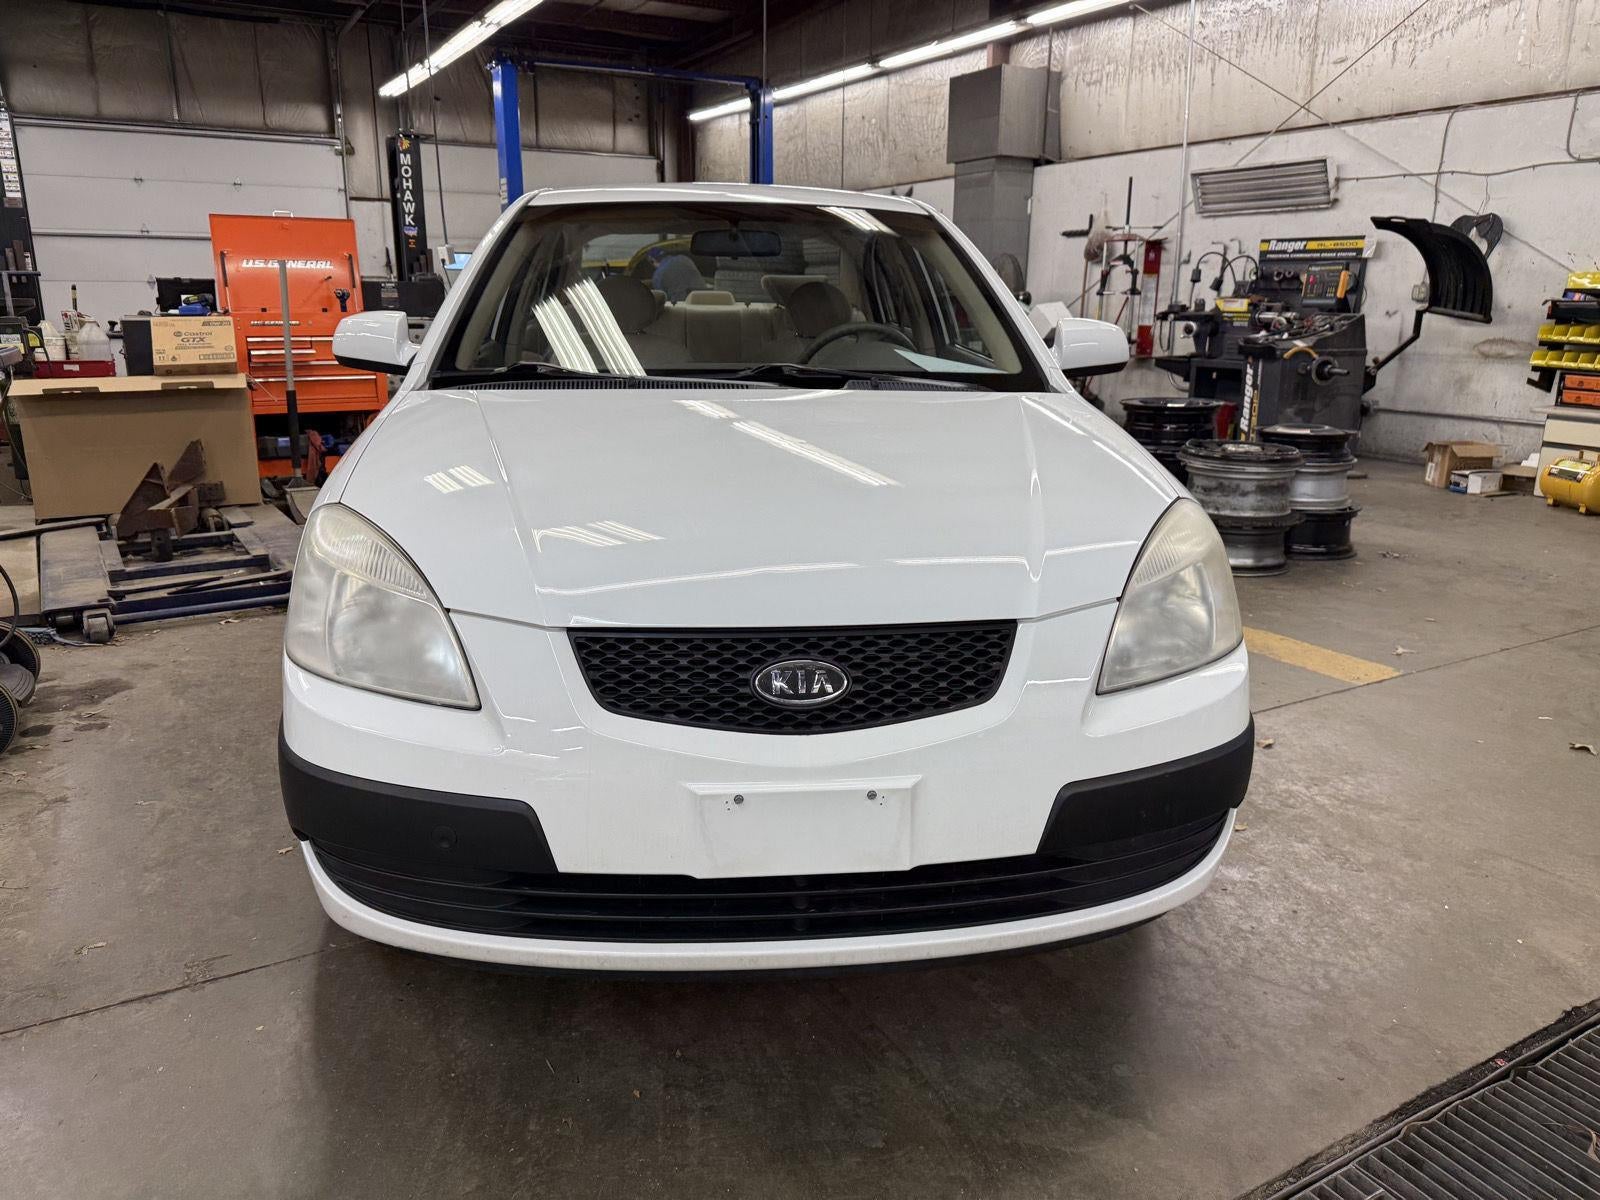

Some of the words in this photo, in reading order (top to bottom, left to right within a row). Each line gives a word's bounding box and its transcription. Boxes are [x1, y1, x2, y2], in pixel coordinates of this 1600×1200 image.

[400, 153, 415, 226] MOHAWK
[1268, 240, 1307, 252] Ranger
[1240, 363, 1254, 432] Ranger
[770, 669, 834, 695] KIA
